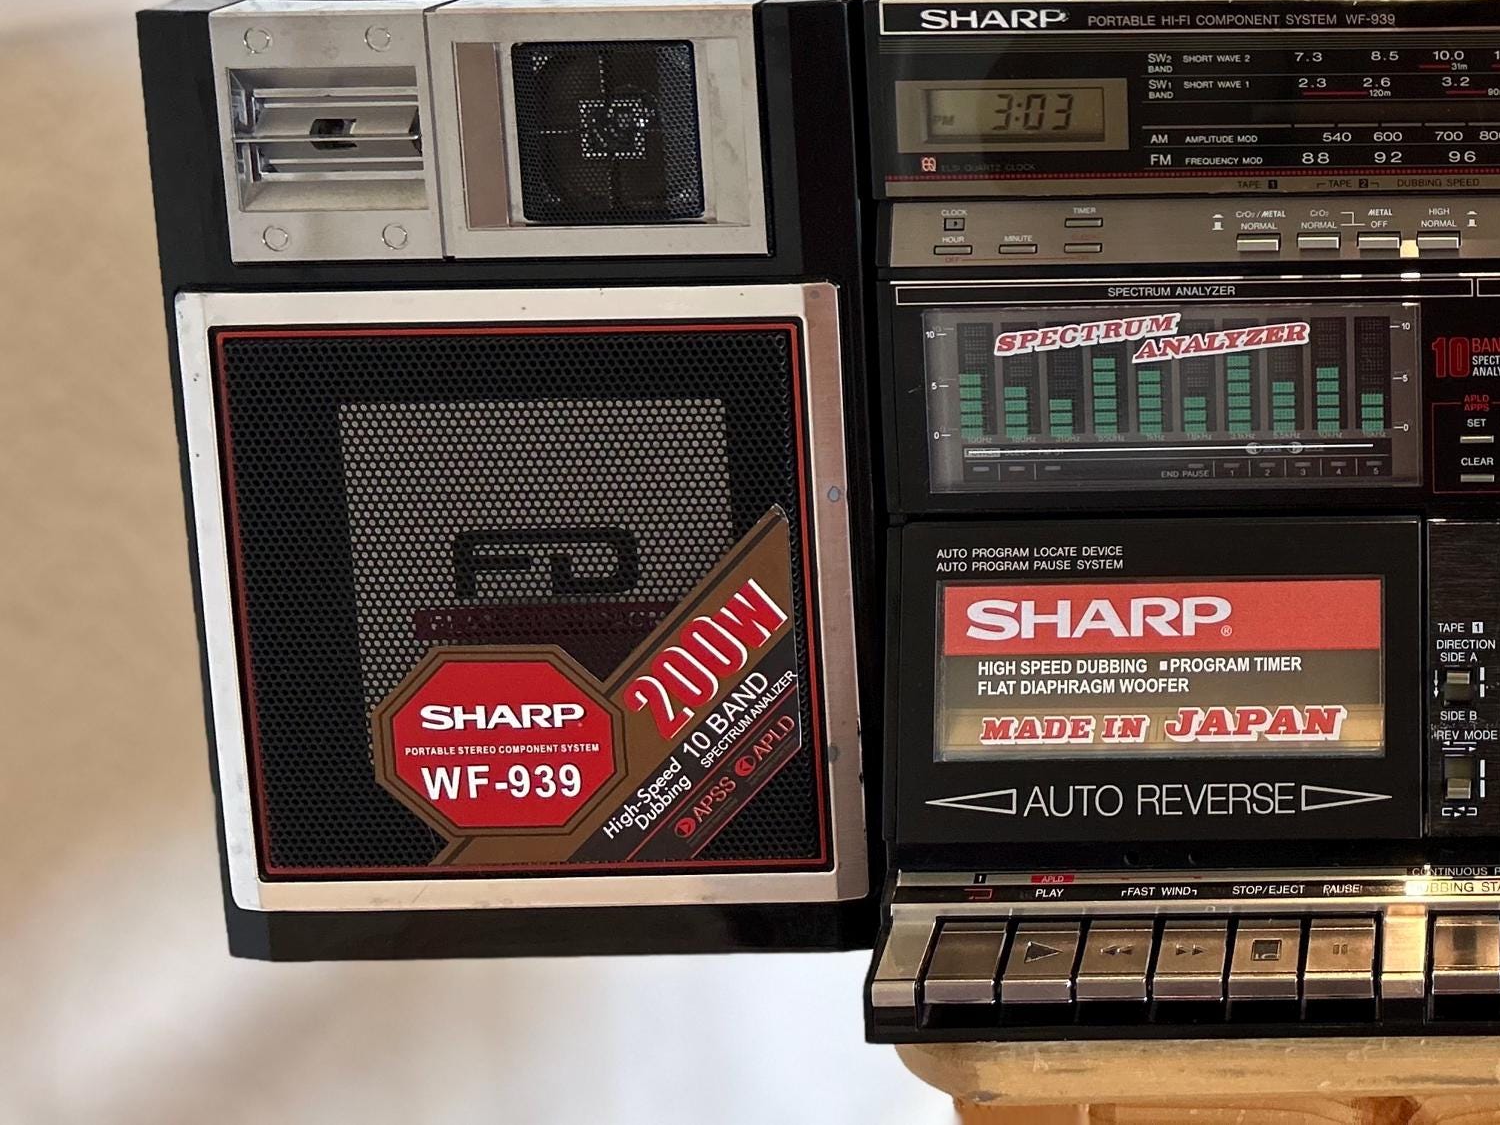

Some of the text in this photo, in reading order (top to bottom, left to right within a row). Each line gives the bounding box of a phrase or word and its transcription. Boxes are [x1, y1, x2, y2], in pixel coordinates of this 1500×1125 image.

[920, 9, 1396, 29] SHARP PORTABLE HI-FI COMPONENT SYSTEM WF-939
[1294, 51, 1323, 62] 7.3
[1371, 50, 1399, 61] 8.5
[1432, 50, 1465, 61] 10.0
[991, 93, 1073, 131] 3:03
[1150, 154, 1263, 166] FM FREQUENCY MOD
[1301, 152, 1330, 165] 88
[1374, 151, 1403, 164] 92
[1448, 150, 1477, 163] 96
[1107, 284, 1236, 298] SPECTRUM ANALYZER
[995, 315, 1178, 355] SPECTRUM
[1135, 323, 1308, 361] ANALYZER
[1431, 337, 1470, 378] 10
[1466, 418, 1487, 428] SET
[1460, 457, 1494, 467] CLEAR
[937, 546, 1123, 559] AUTO PROGRAM LOCATE DEVICE
[937, 559, 1123, 572] AUTO PROGRAM PAUSE SYSTEM
[966, 595, 1232, 641] SHARP
[1437, 622, 1466, 633] TAPE
[1436, 639, 1496, 650] DIRECTION
[621, 578, 788, 742] 200W
[1169, 655, 1302, 673] PROGRAM TIMER
[1440, 652, 1478, 662] SIDE A
[977, 657, 1148, 676] HIGH SPEED DUBBING
[977, 676, 1190, 696] FLAT DIAPHRAGM WOOFER
[420, 703, 585, 730] SHARP
[683, 672, 768, 759] 10 BAND
[700, 670, 798, 769] SPECTRUM ANALIZER
[980, 705, 1347, 744] MADE IN JAPAN
[1440, 711, 1478, 721] SIDE B
[1437, 730, 1498, 740] REV MODE
[405, 742, 600, 756] PORTABLE STEREO COMPONENT SYSTEM
[693, 715, 795, 822] APSS APLD
[420, 764, 583, 801] WF-939
[603, 756, 682, 839] High-Speed
[634, 774, 692, 830] Dubbing
[1023, 782, 1296, 817] AUTO REVERSE
[1412, 867, 1488, 876] CONTINUOUS
[1035, 888, 1064, 898] PLAY
[1128, 886, 1190, 897] FAST WIND
[1232, 885, 1305, 895] STOP/EJECT
